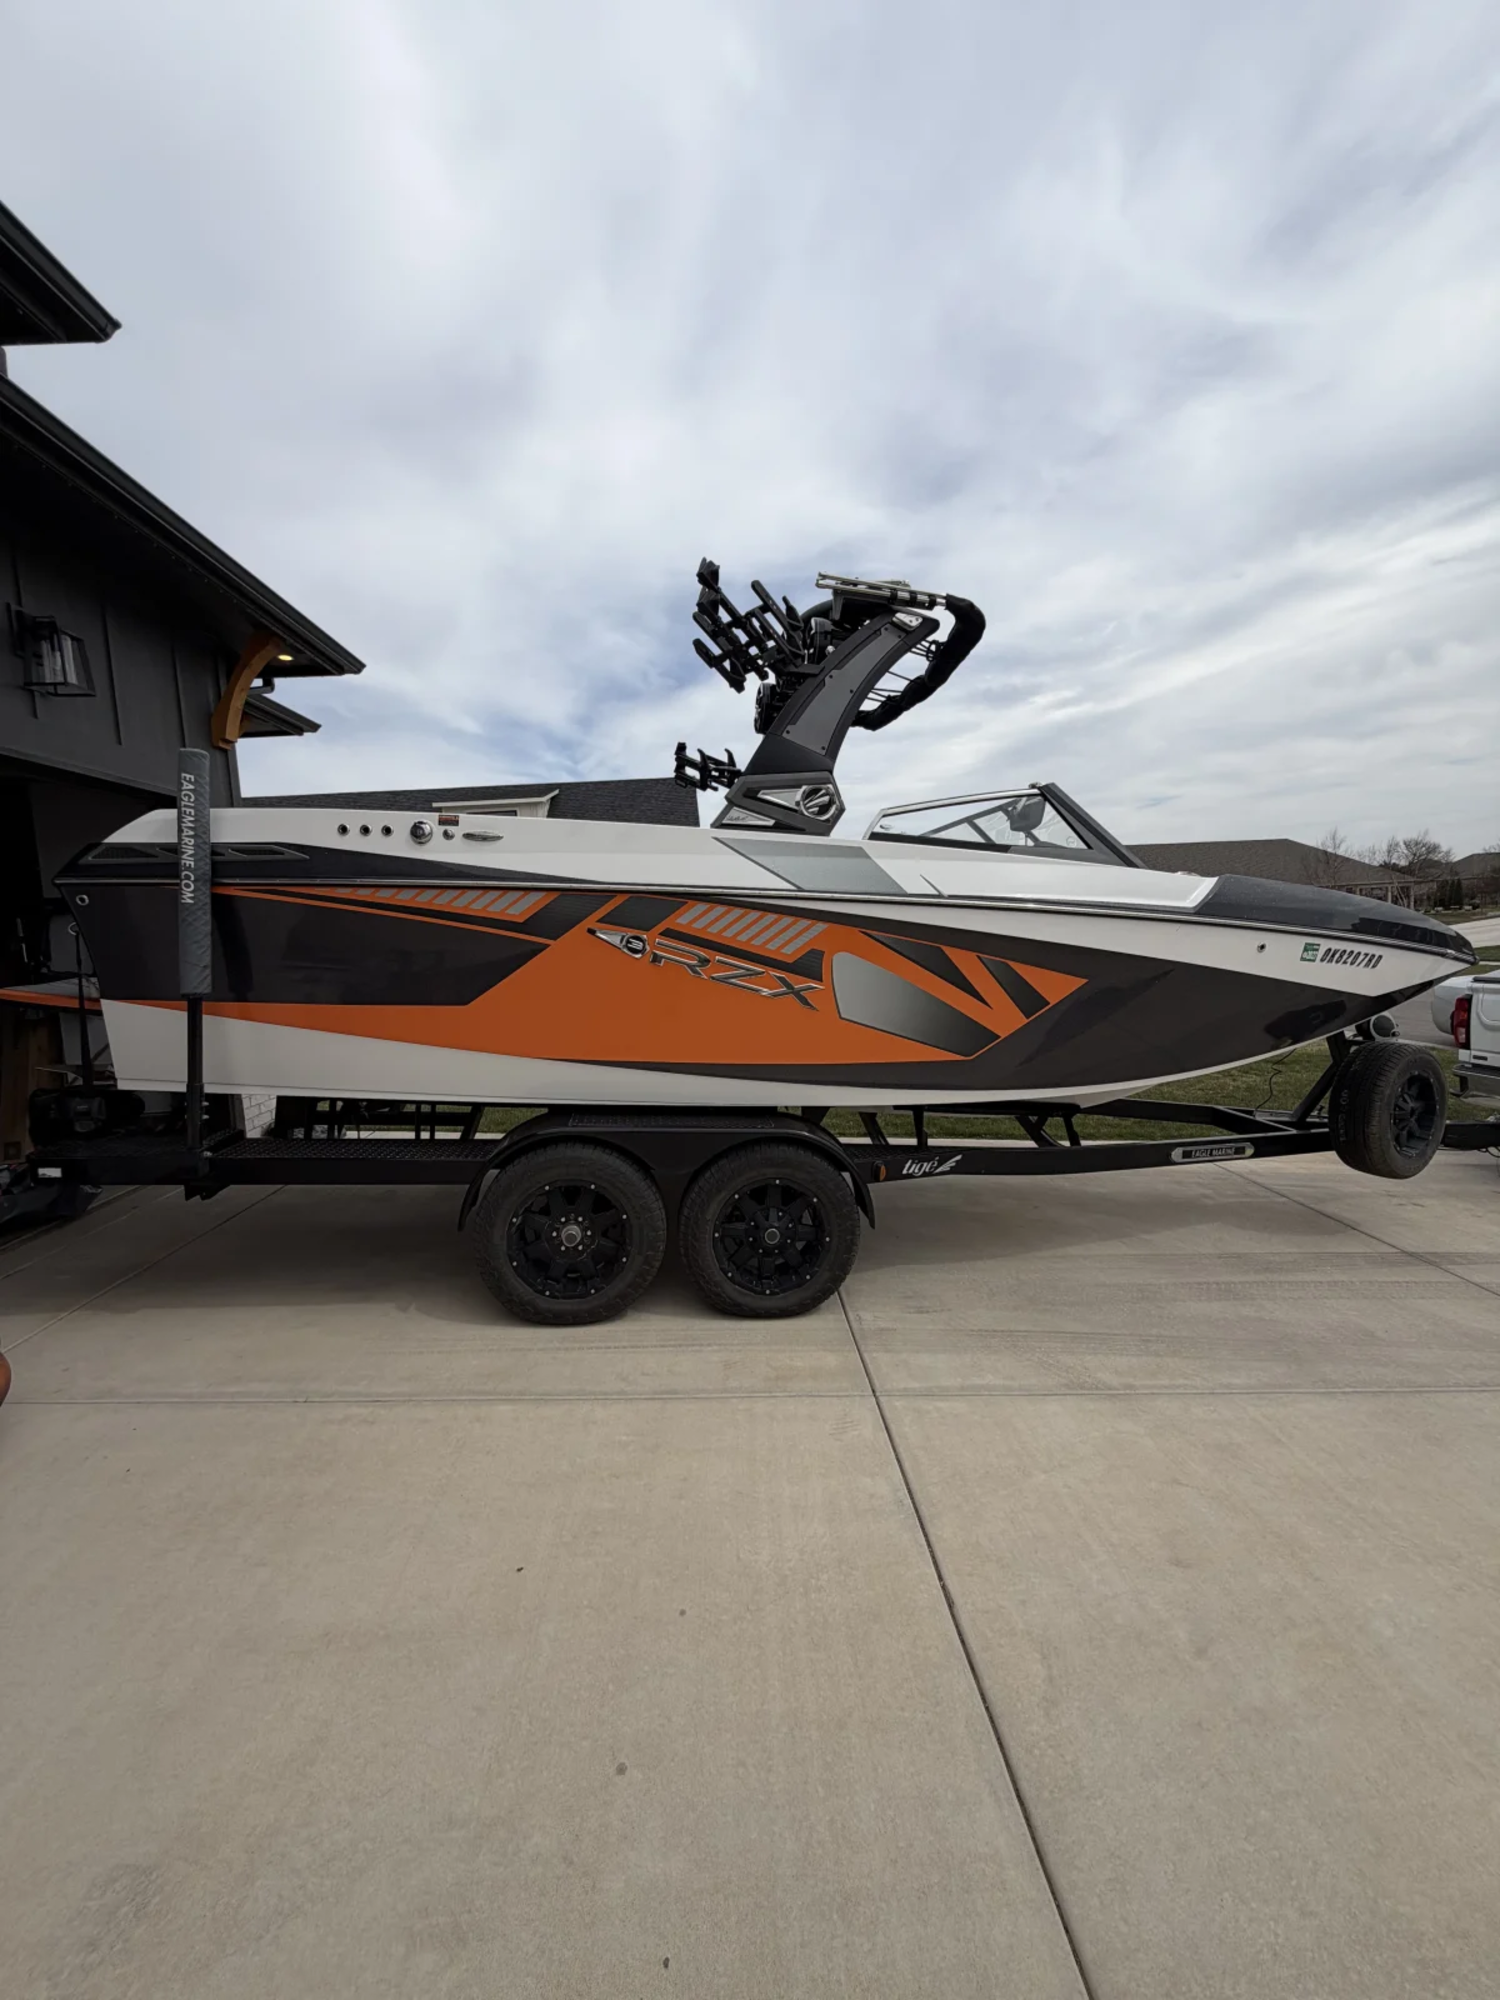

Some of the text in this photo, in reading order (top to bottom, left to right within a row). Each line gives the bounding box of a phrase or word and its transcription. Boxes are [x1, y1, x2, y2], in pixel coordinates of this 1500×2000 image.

[180, 772, 195, 904] EAGLEMARINE.COM
[649, 938, 825, 1011] RZX
[1320, 946, 1383, 969] OK8207RD
[1191, 1147, 1235, 1159] EAGLE MARINE
